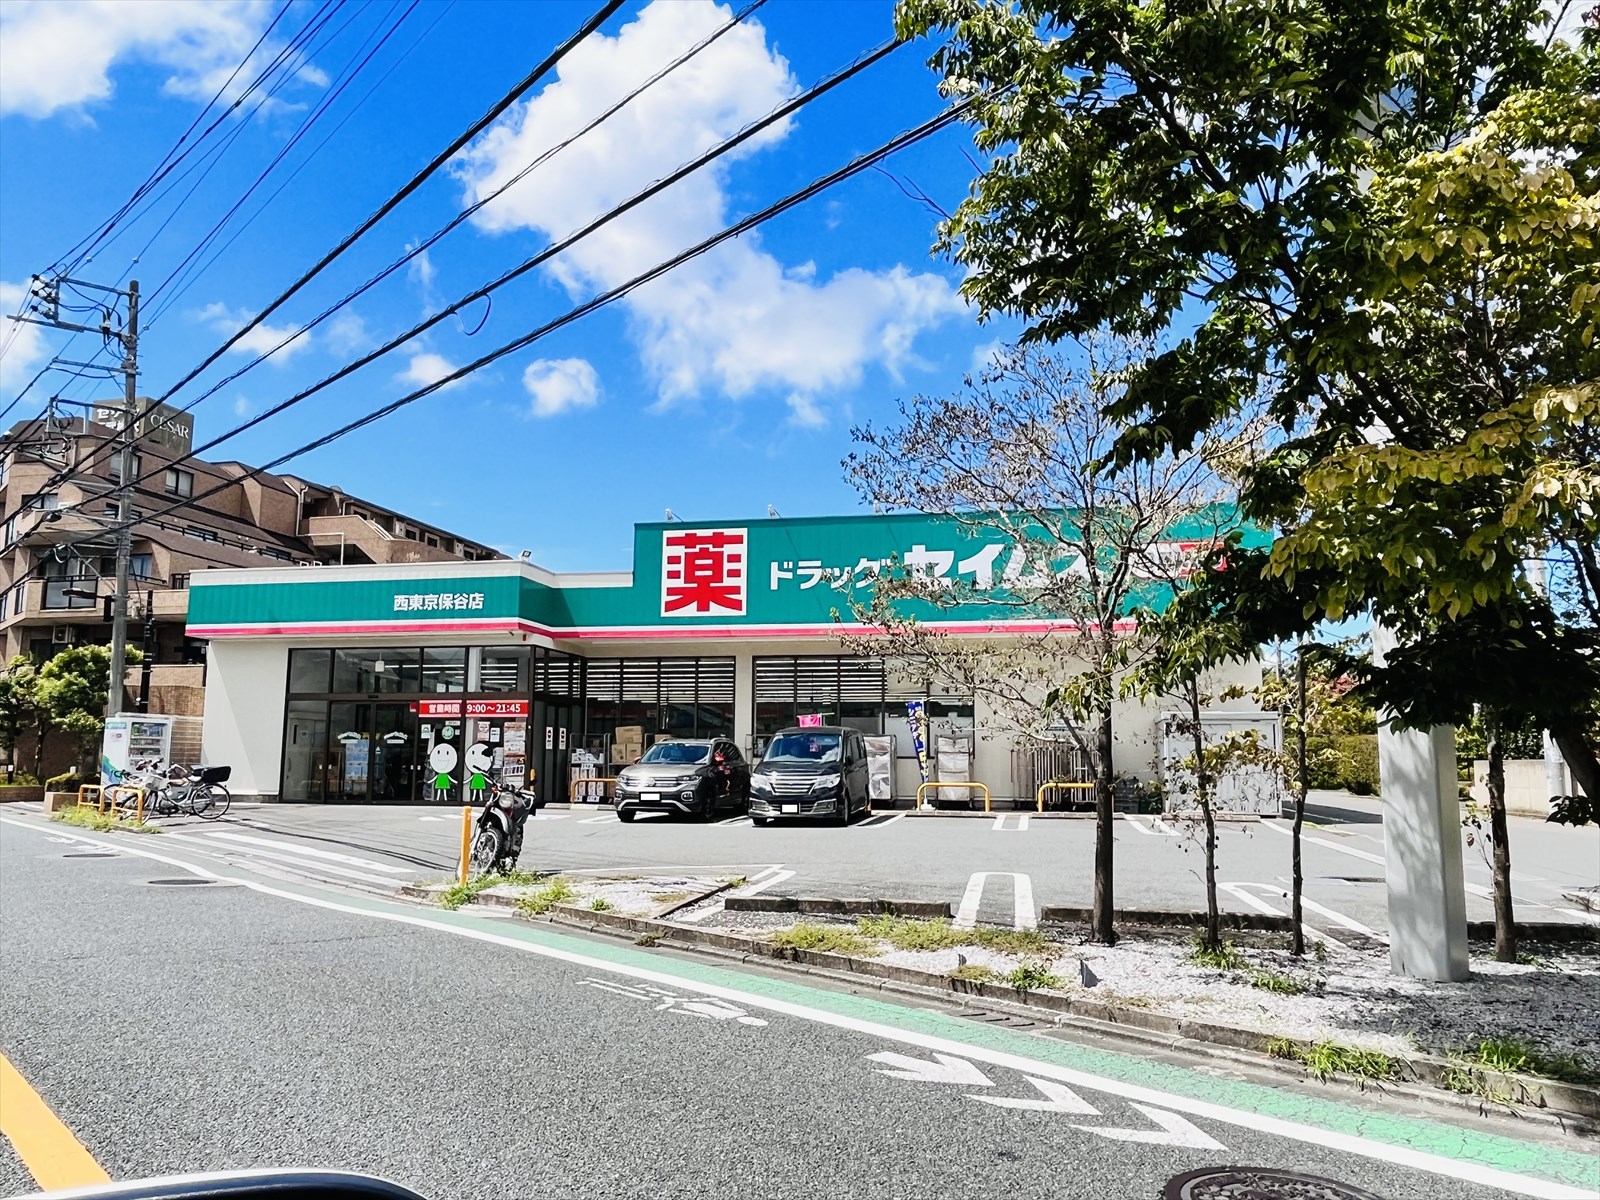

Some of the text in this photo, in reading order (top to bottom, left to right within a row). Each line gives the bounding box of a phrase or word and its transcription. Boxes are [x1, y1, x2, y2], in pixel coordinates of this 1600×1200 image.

[664, 531, 743, 612] 薬
[770, 557, 891, 590] ドラッグ
[393, 592, 485, 611] 西東京保谷店
[428, 704, 460, 714] 営業時間
